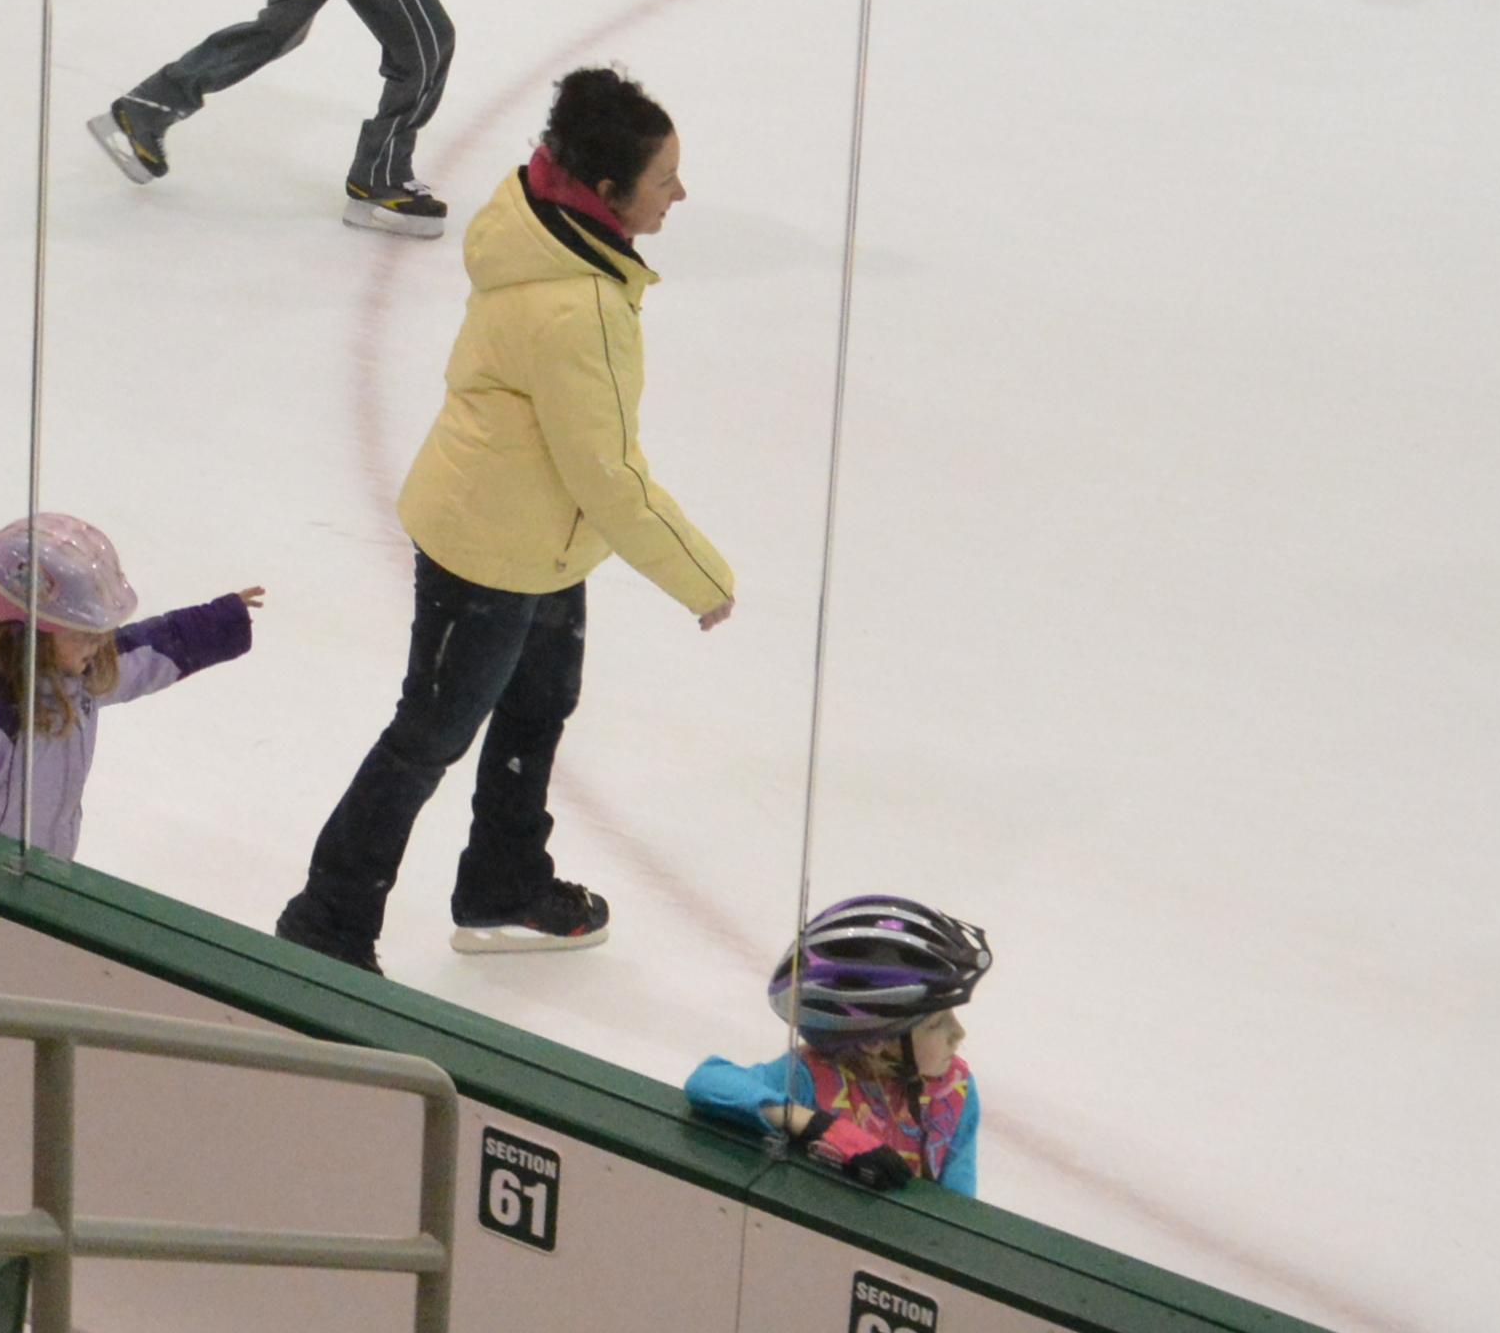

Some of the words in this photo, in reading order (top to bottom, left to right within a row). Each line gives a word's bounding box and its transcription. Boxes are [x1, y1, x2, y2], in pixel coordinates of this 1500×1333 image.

[485, 1137, 557, 1179] SECTION
[489, 1168, 548, 1238] 61
[855, 1281, 935, 1327] SECTION
